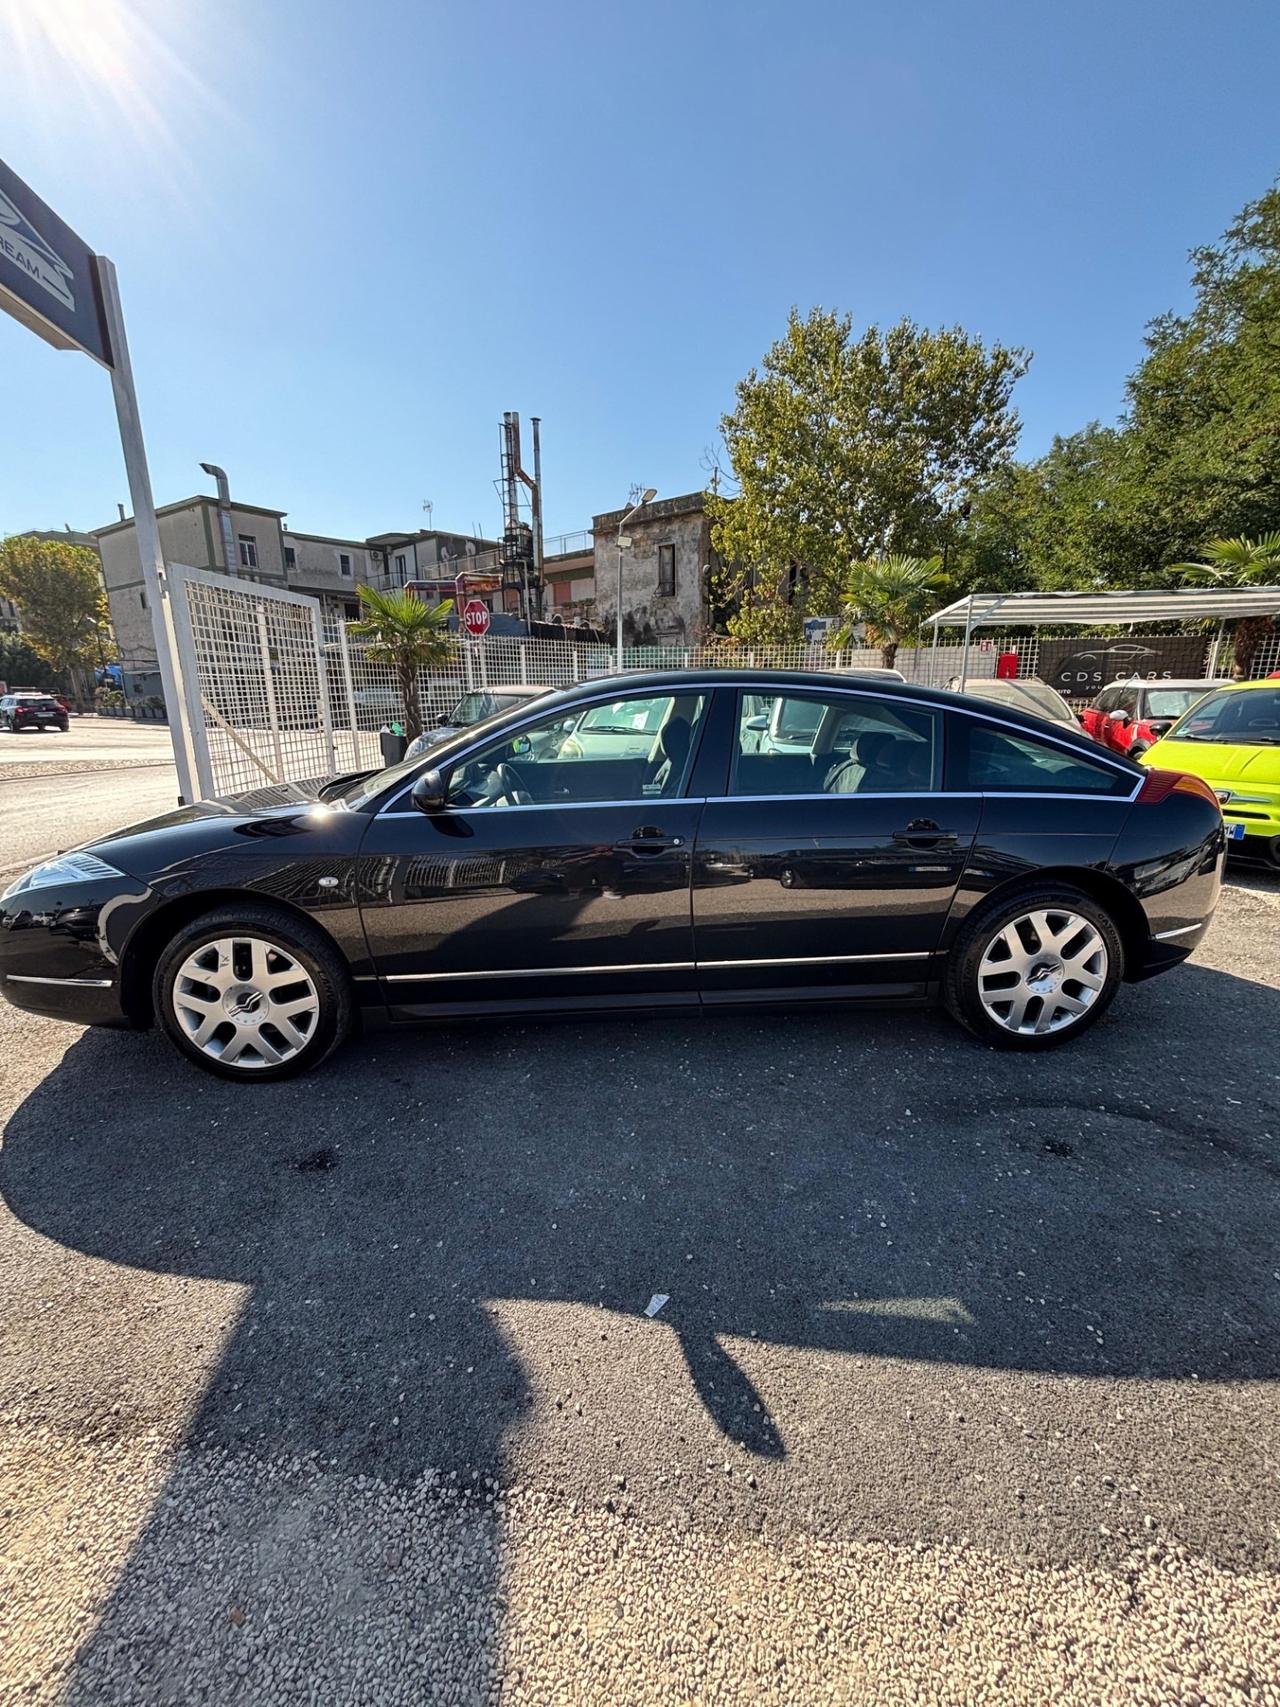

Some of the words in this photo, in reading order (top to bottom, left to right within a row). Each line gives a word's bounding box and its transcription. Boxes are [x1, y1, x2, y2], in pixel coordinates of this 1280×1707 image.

[466, 611, 488, 625] STOP
[1061, 671, 1103, 682] CDS
[1115, 670, 1173, 681] CARS
